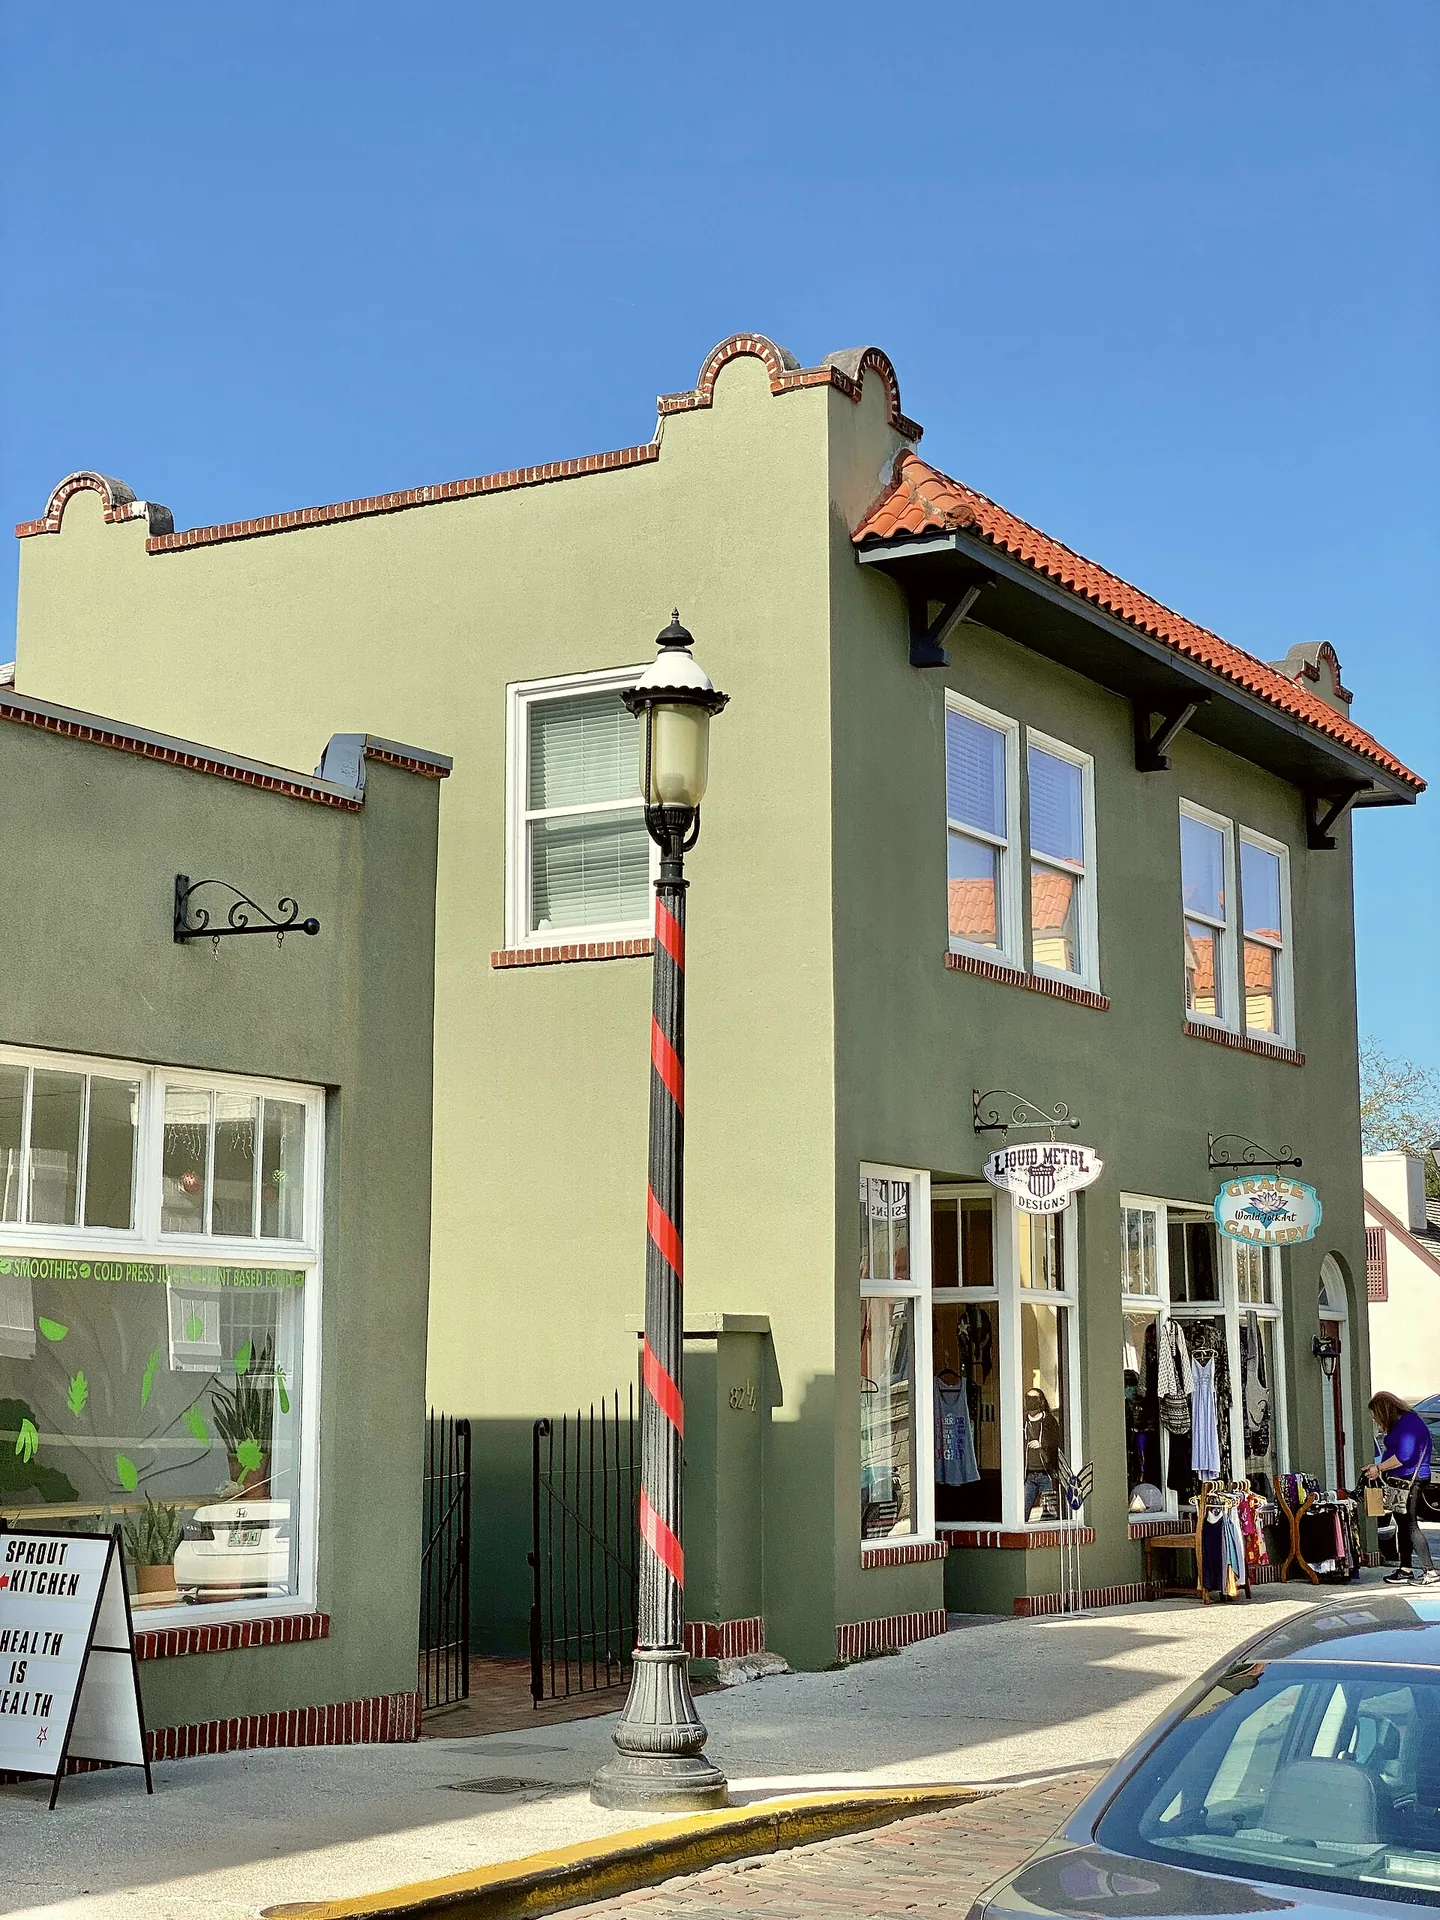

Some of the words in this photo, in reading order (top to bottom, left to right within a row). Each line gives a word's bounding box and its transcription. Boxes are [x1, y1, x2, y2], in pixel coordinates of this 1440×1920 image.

[994, 1147, 1038, 1175] LIQUID
[1043, 1147, 1089, 1173] METAL
[1226, 1178, 1307, 1200] GRACE
[1018, 1195, 1065, 1210] DESIGNS
[1235, 1210, 1260, 1221] World
[1281, 1213, 1297, 1222] Art
[1224, 1220, 1309, 1243] GALLERY
[13, 1258, 78, 1280] SMOOTHIES
[94, 1262, 122, 1281] COLD
[126, 1263, 154, 1283] PRESS
[234, 1270, 262, 1287] BASED
[266, 1271, 292, 1288] FOOD
[6, 1540, 68, 1566] SPROUT
[9, 1569, 80, 1597] KITCHEN
[0, 1630, 63, 1656] HEALTH
[9, 1661, 28, 1684] IS
[0, 1690, 53, 1717] EALTH
